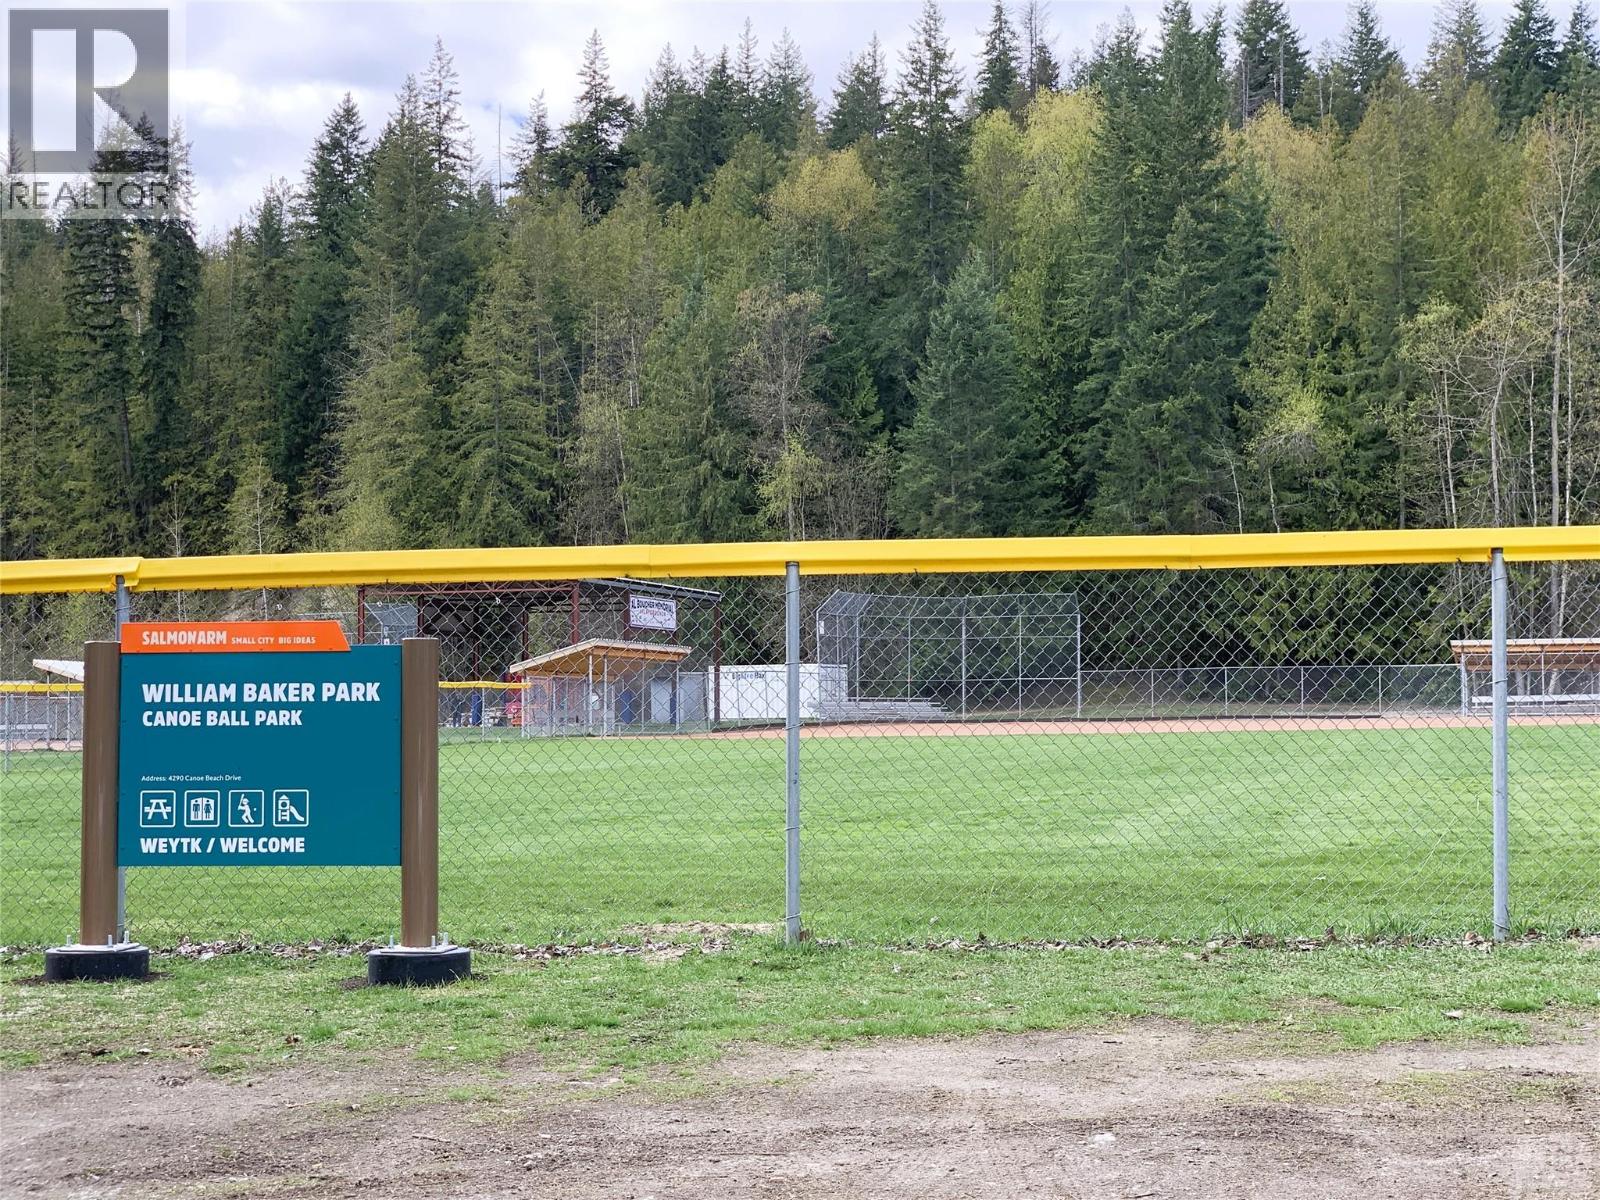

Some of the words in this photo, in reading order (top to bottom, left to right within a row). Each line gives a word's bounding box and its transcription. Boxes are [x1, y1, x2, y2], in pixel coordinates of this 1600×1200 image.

[231, 637, 256, 645] SMALL
[257, 637, 275, 645] CITY
[293, 636, 316, 644] IDEAS
[142, 683, 236, 703] WILLIAM
[244, 683, 315, 702] BAKER
[322, 682, 381, 702] PARK
[143, 711, 202, 727] CANOE
[206, 711, 250, 727] BALL
[255, 710, 303, 726] PARK
[205, 774, 224, 782] Beach
[225, 774, 242, 782] Drive
[140, 838, 202, 854] WEYTK
[220, 837, 305, 853] WELCOME
